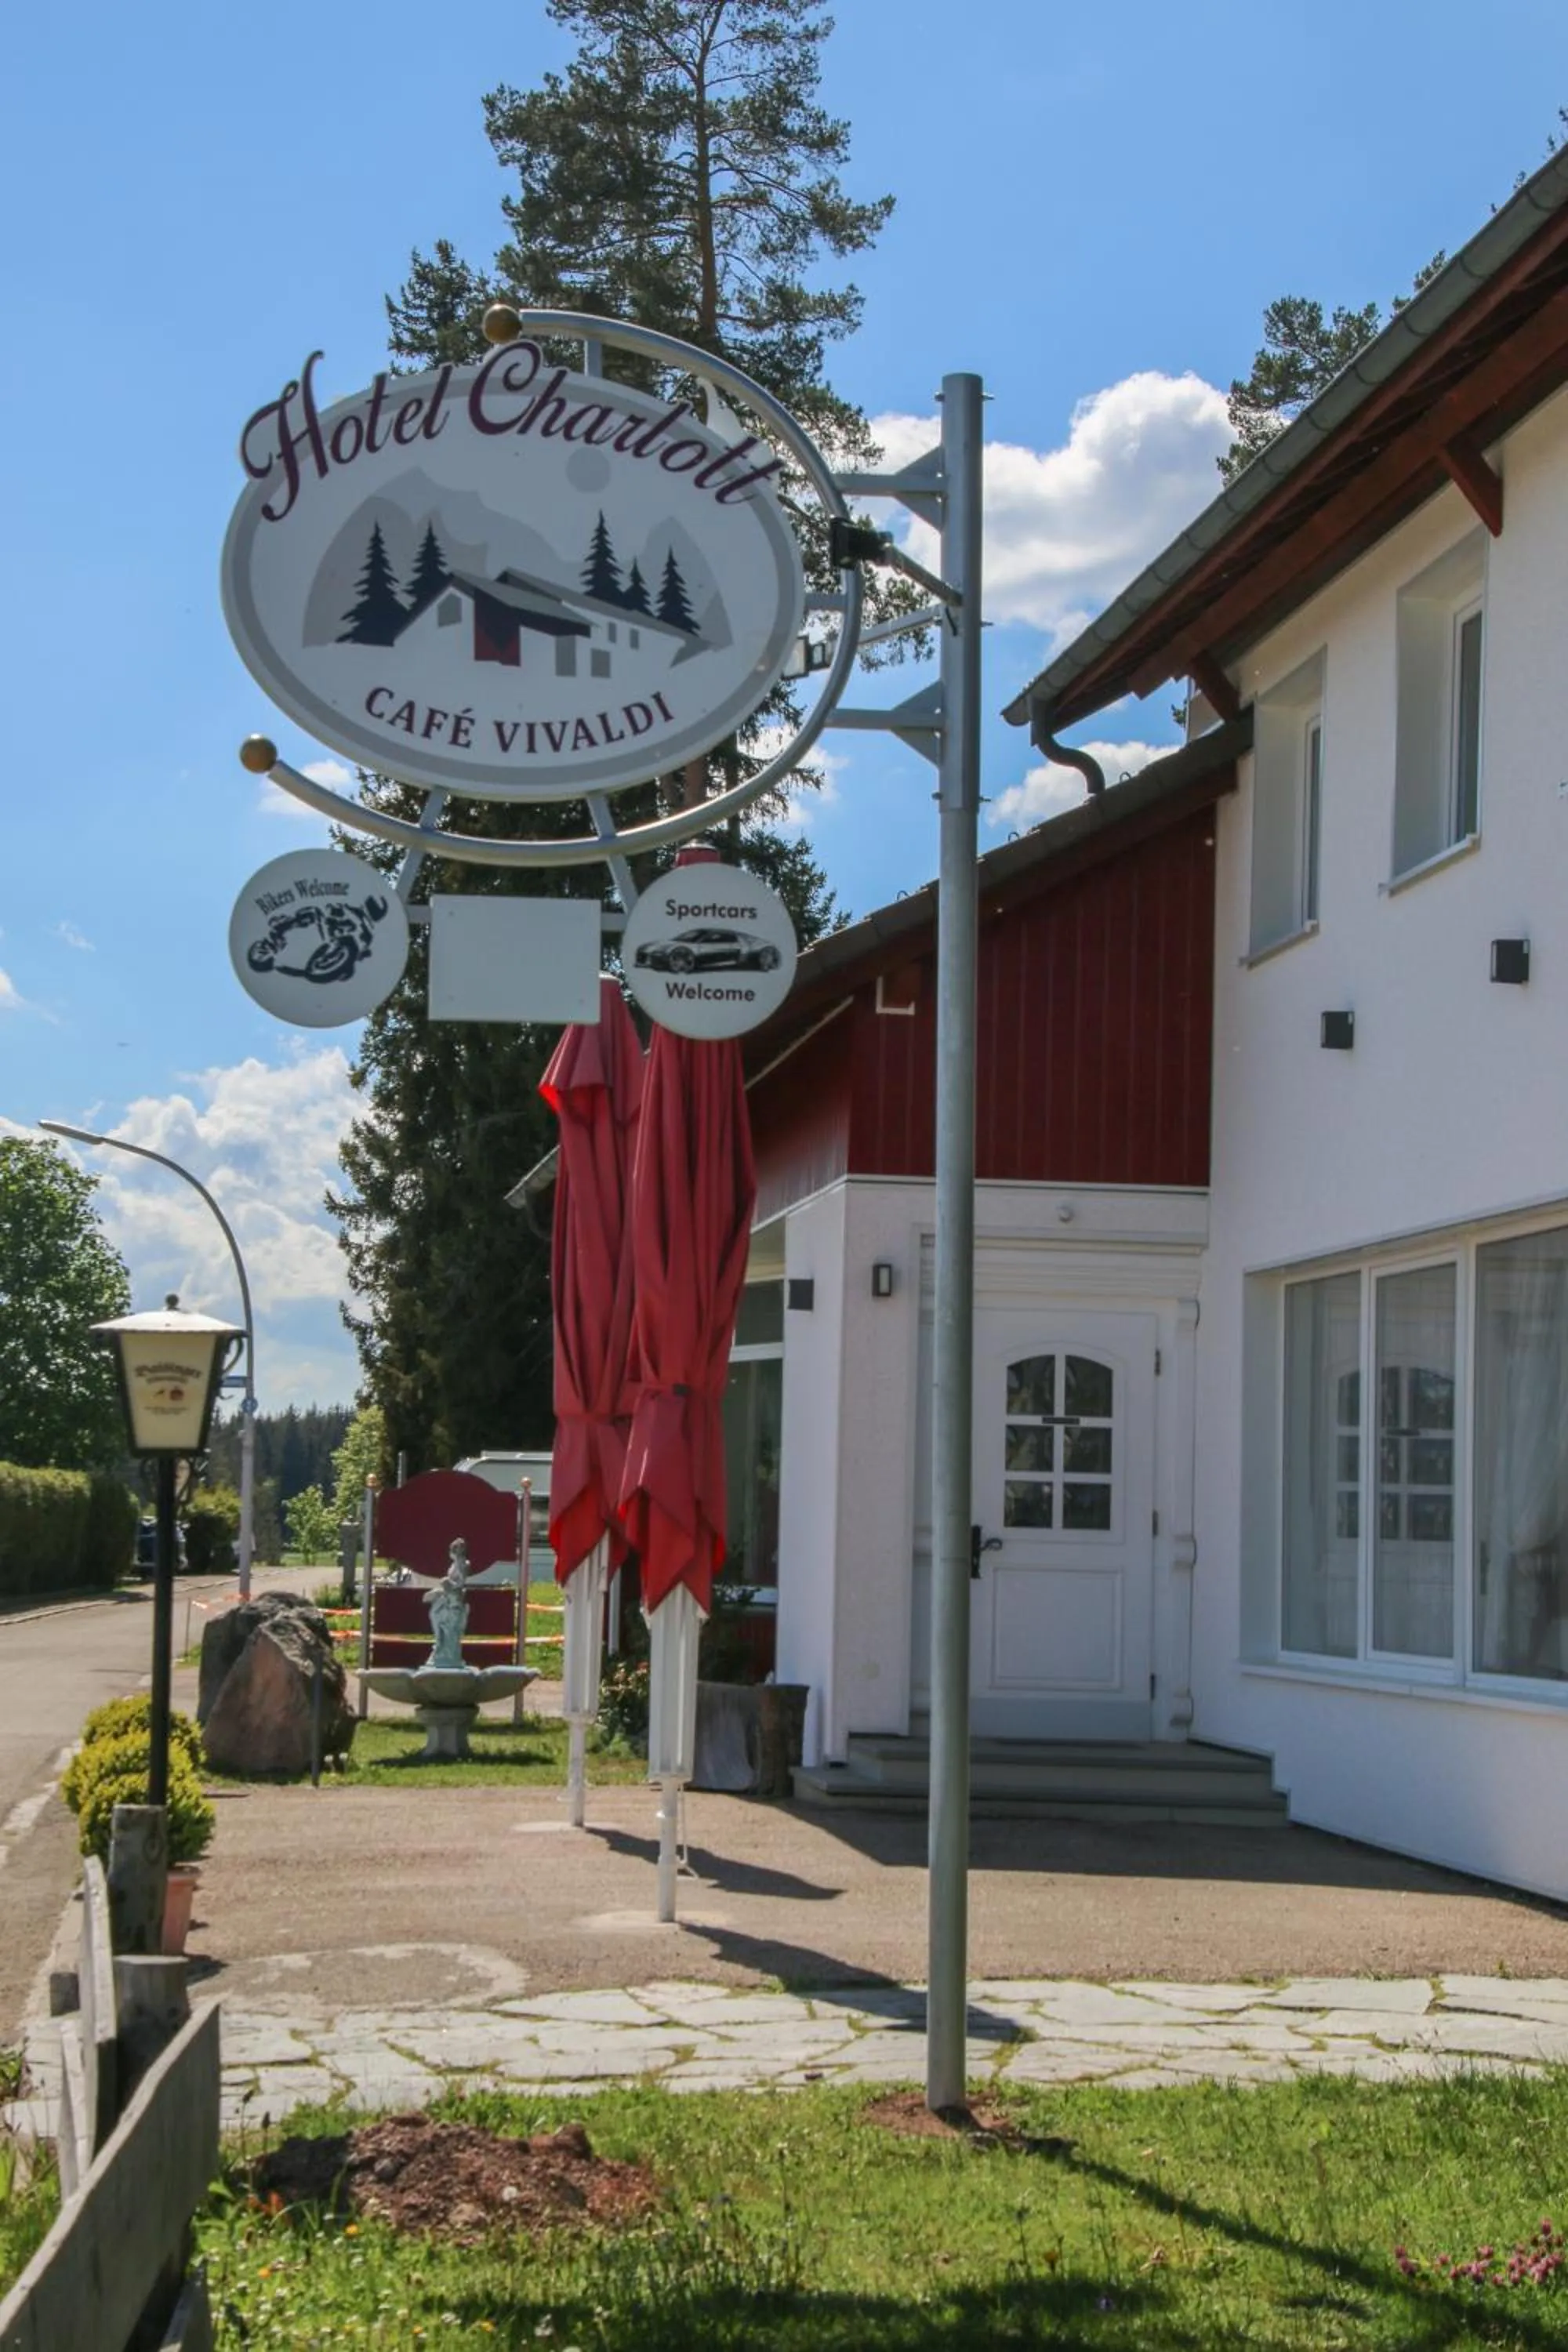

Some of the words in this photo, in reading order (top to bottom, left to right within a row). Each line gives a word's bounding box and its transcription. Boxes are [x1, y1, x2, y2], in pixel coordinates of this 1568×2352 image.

[241, 350, 452, 521] Hotel
[468, 340, 785, 504] Charlott
[365, 687, 475, 749] CAFÉ
[493, 691, 675, 753] VIVALDI
[254, 888, 296, 916] Bikers
[293, 877, 350, 898] Welcome
[666, 898, 758, 920] Sportcars
[665, 982, 756, 1002] Welcome
